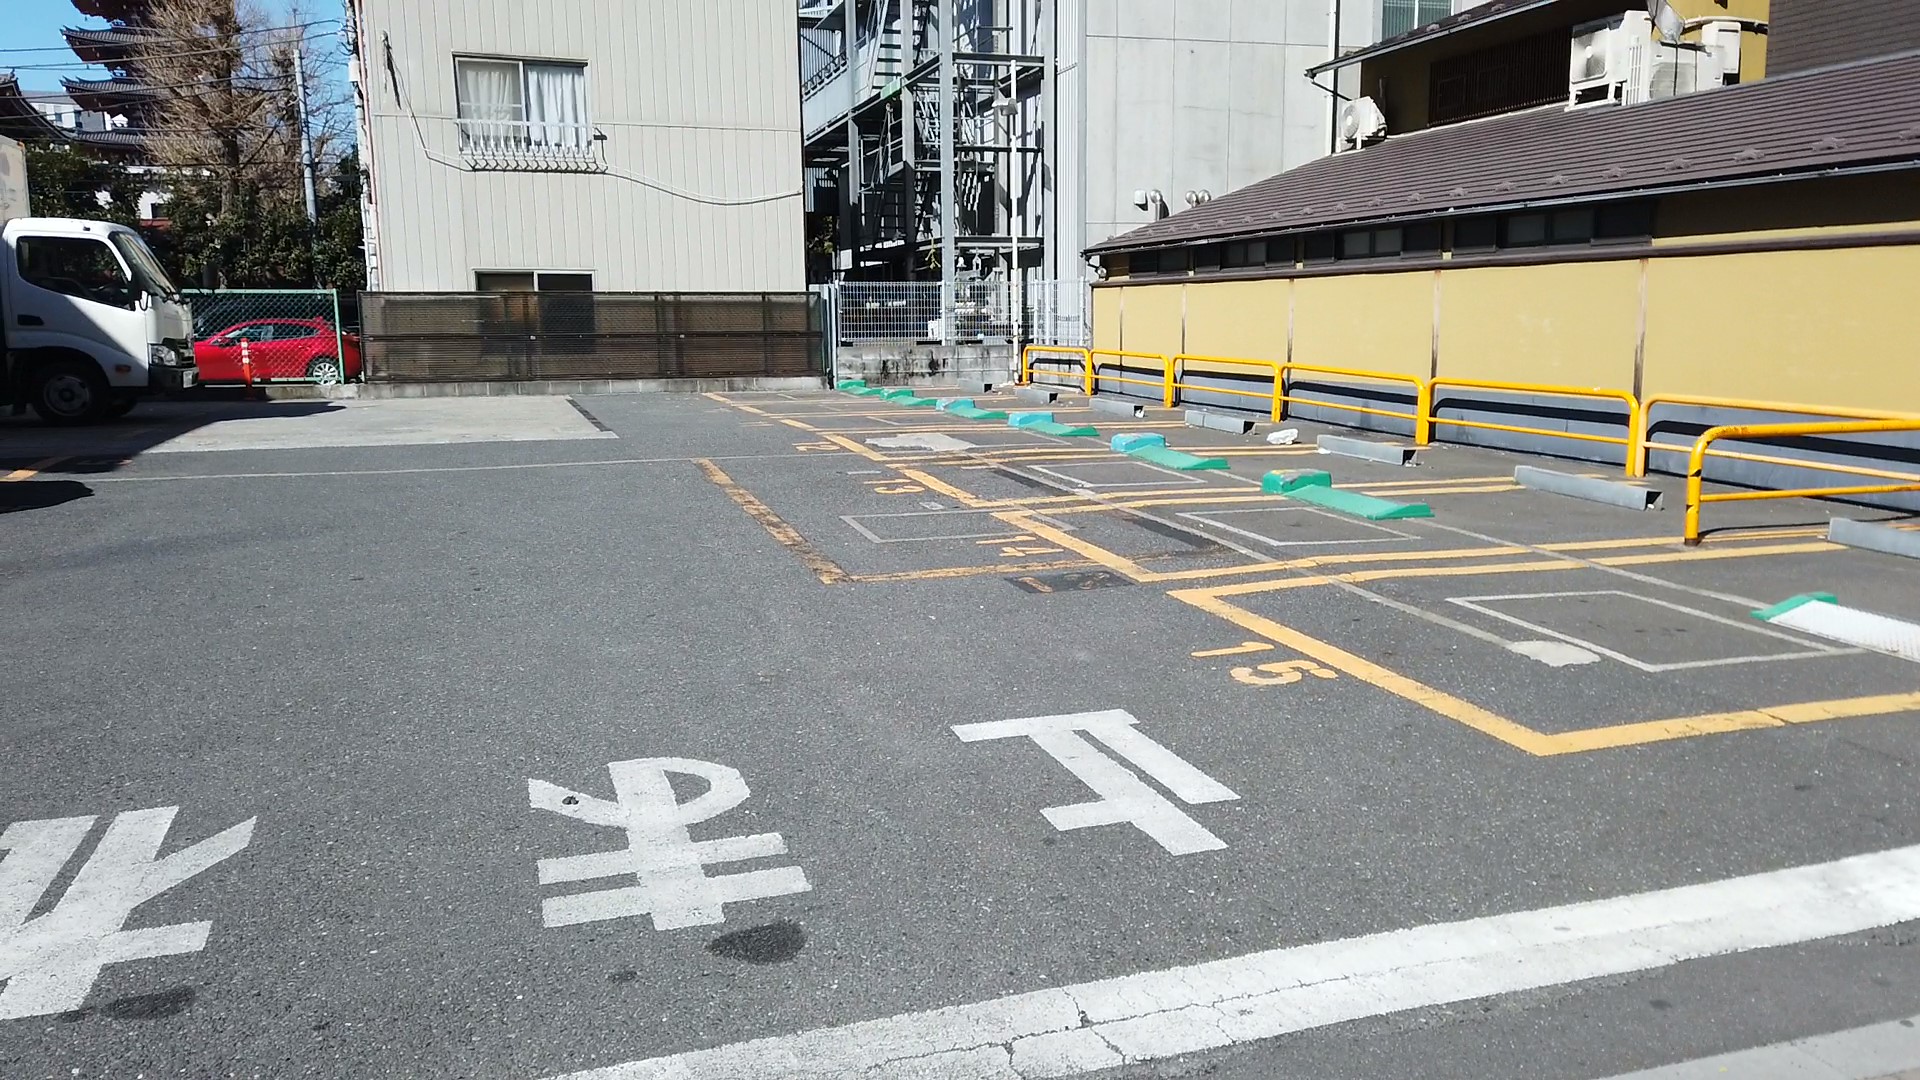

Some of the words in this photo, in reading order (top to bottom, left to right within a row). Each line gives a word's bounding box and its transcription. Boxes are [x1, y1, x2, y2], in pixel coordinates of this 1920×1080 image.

[792, 441, 840, 451] 12
[863, 478, 925, 494] 13
[976, 535, 1064, 557] 14
[1190, 641, 1338, 686] 15
